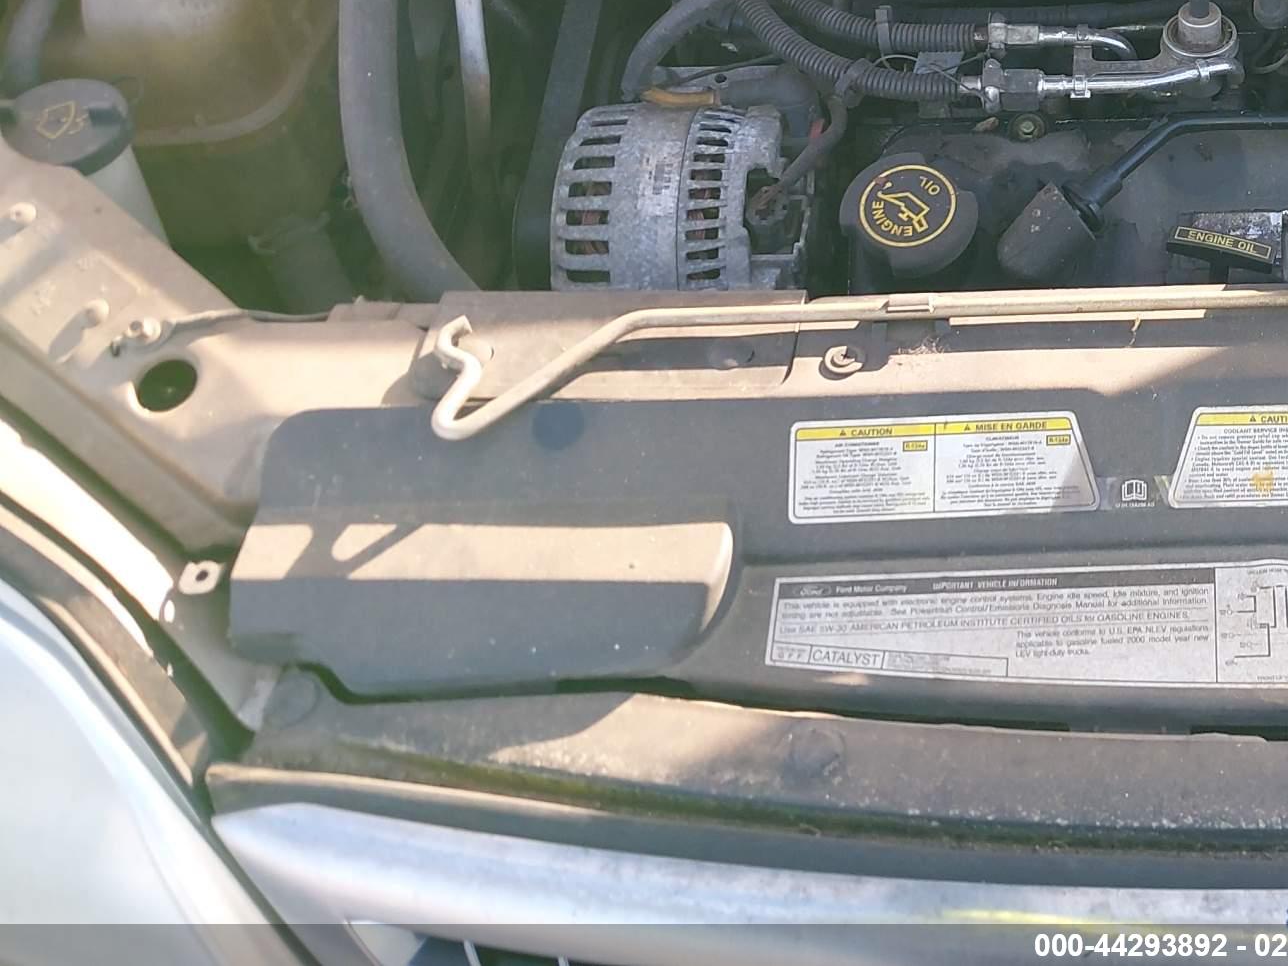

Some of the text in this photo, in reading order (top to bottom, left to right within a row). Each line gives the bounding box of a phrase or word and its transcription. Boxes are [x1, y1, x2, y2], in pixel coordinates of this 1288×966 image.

[920, 176, 940, 195] OIL
[872, 201, 913, 236] ENGINE
[1188, 231, 1256, 253] ENGINE OIL
[851, 428, 893, 436] CAUTION
[875, 585, 907, 593] Company
[1008, 578, 1057, 587] INFORMATION
[1037, 593, 1063, 603] Engine
[1164, 587, 1178, 596] and
[1075, 600, 1105, 609] Manual
[1108, 599, 1118, 607] for
[1121, 598, 1160, 607] additional
[851, 623, 898, 631] AMERICAN
[901, 621, 958, 629] PETROLEUM
[961, 618, 1007, 628] INSTITUTE
[1010, 617, 1058, 626] CERTIFIED
[1061, 615, 1082, 623] OILS
[1085, 614, 1094, 622] for
[1097, 612, 1144, 623] GASOLINE
[1127, 625, 1142, 634] EPA
[1145, 624, 1167, 632] NLEV
[1127, 635, 1145, 644] 2000
[1149, 634, 1171, 642] model
[1175, 634, 1191, 644] year
[813, 649, 880, 666] CATALYST
